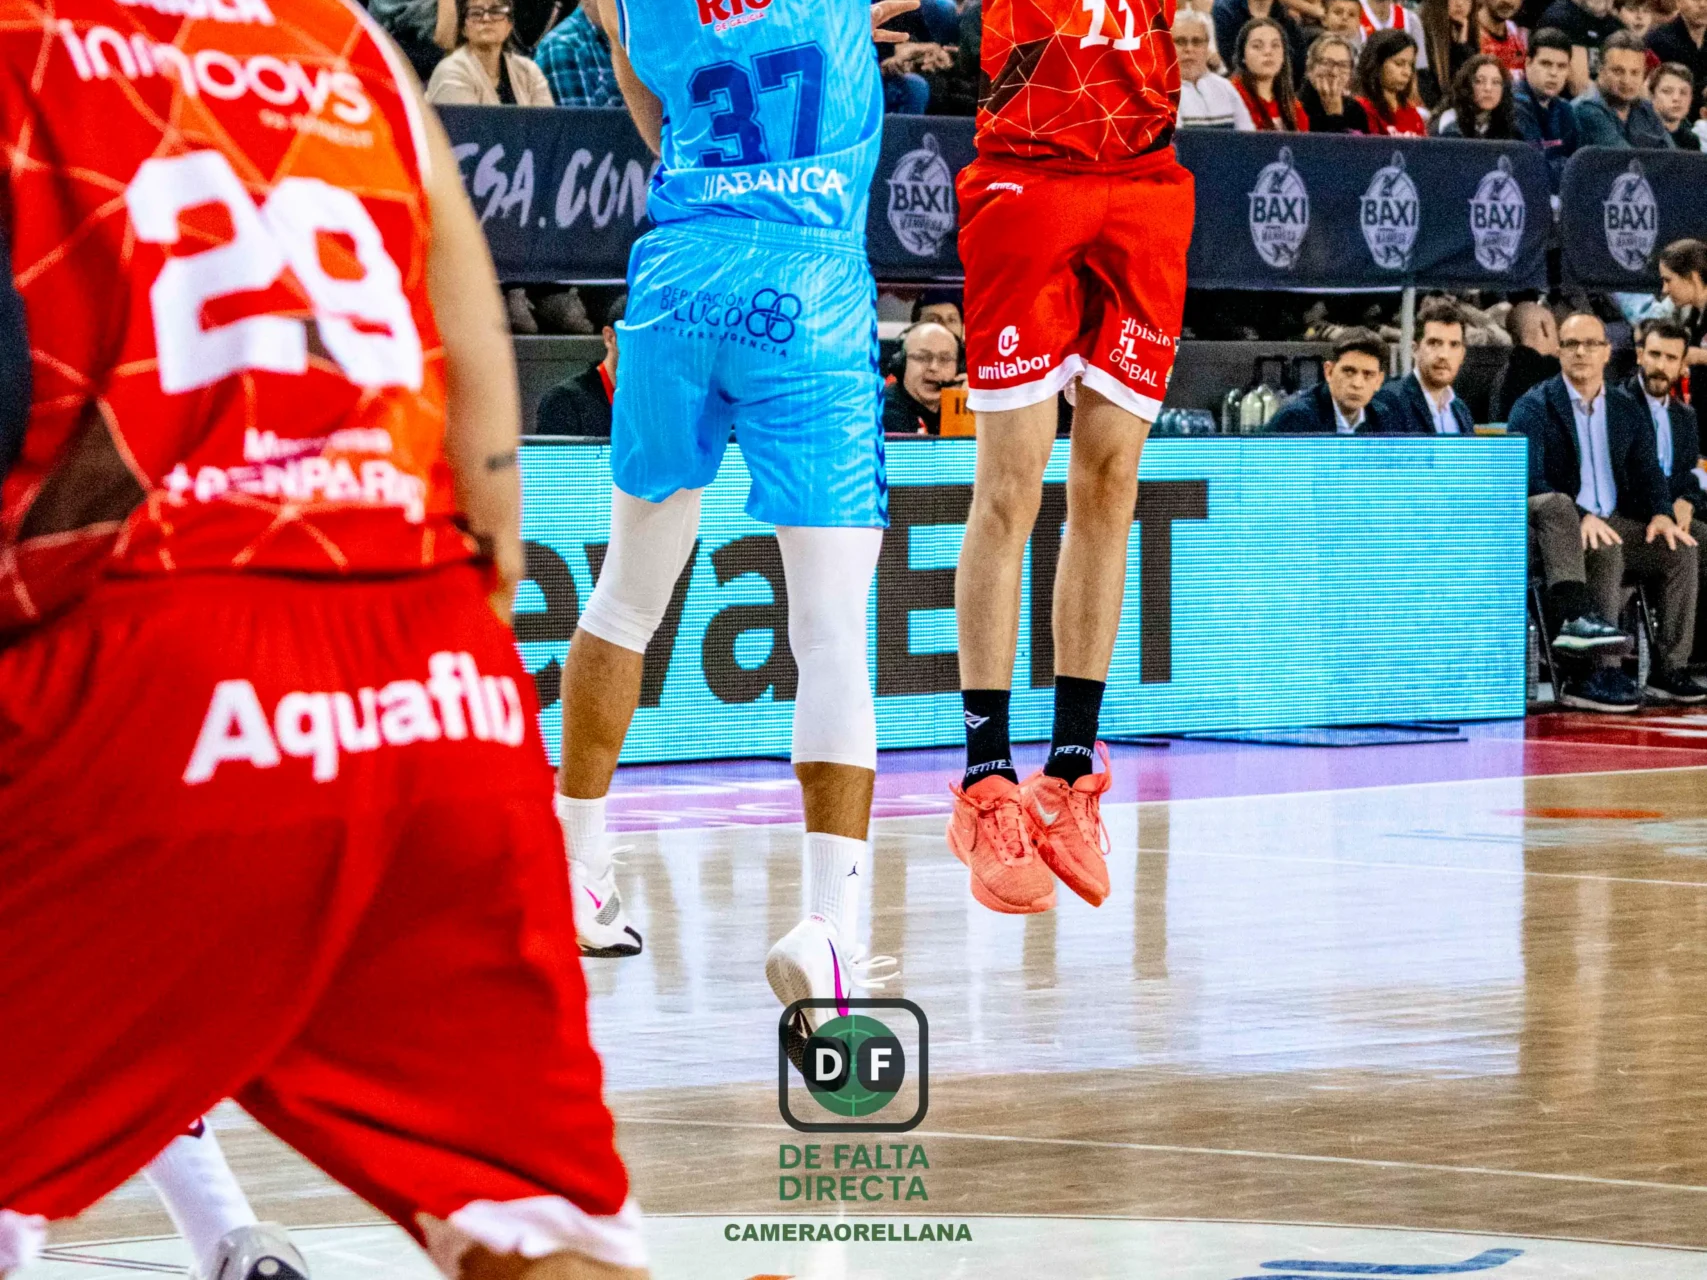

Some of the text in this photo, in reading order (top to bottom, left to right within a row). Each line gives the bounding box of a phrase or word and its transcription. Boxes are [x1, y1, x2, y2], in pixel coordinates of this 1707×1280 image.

[686, 39, 828, 169] 37
[891, 183, 951, 213] BAXI
[1252, 196, 1306, 225] BAXI
[1364, 199, 1417, 227] BAXI
[1474, 203, 1523, 230] BAXI
[1607, 204, 1655, 230] BAXI
[124, 148, 424, 395] 29
[674, 301, 743, 328] LUGO
[978, 353, 1051, 380] unilabor
